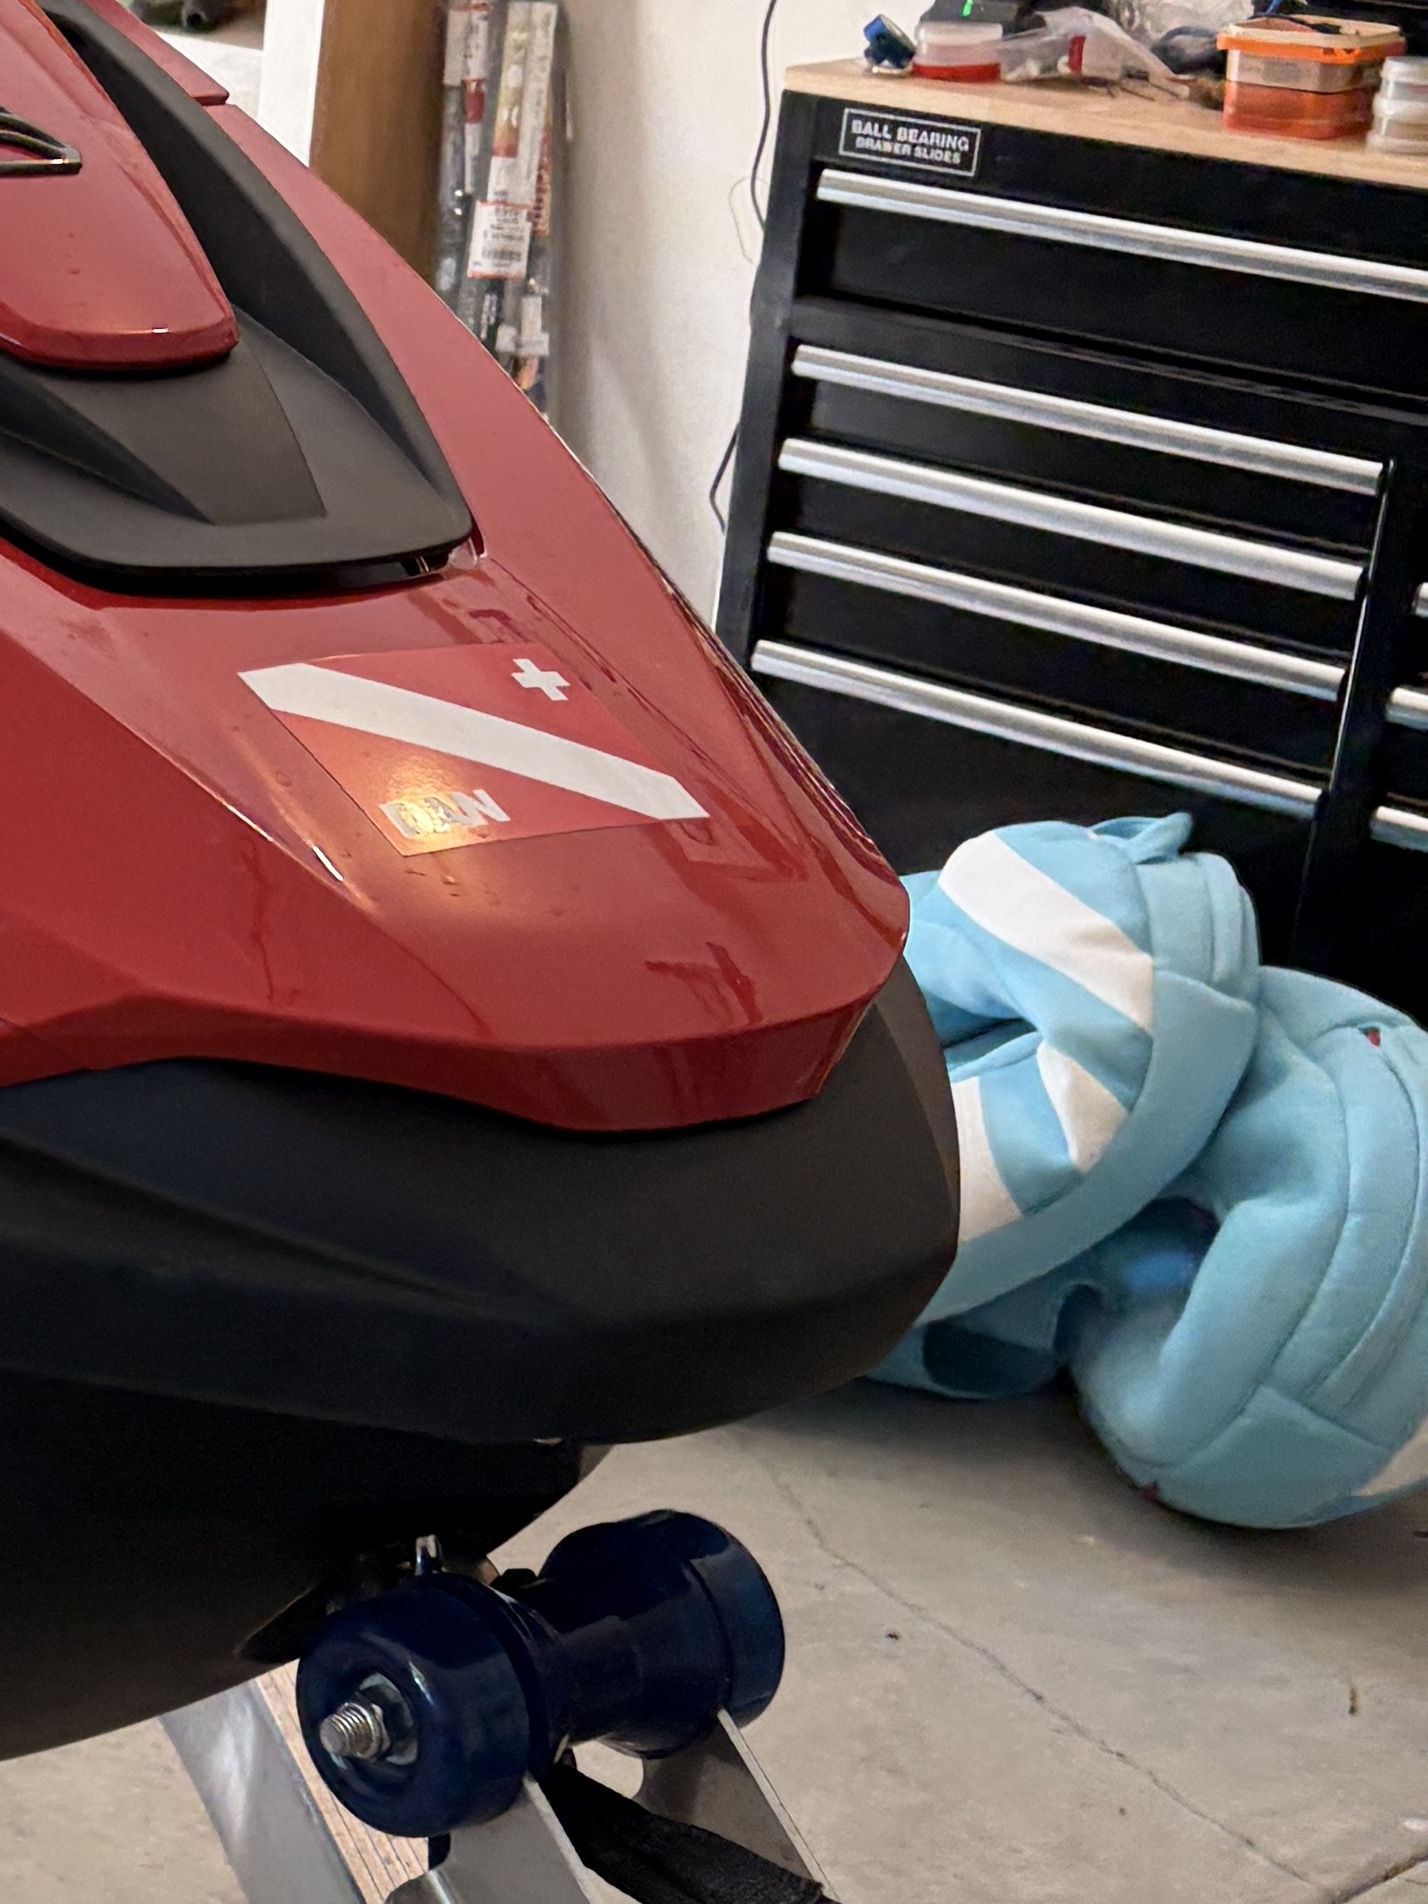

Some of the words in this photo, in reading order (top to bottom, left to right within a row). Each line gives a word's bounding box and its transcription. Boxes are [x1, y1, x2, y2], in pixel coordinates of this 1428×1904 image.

[851, 119, 892, 140] BALL
[896, 127, 970, 152] BEARING
[855, 136, 912, 156] DRAWER
[913, 146, 962, 165] SLIDES
[377, 788, 512, 840] DAN
